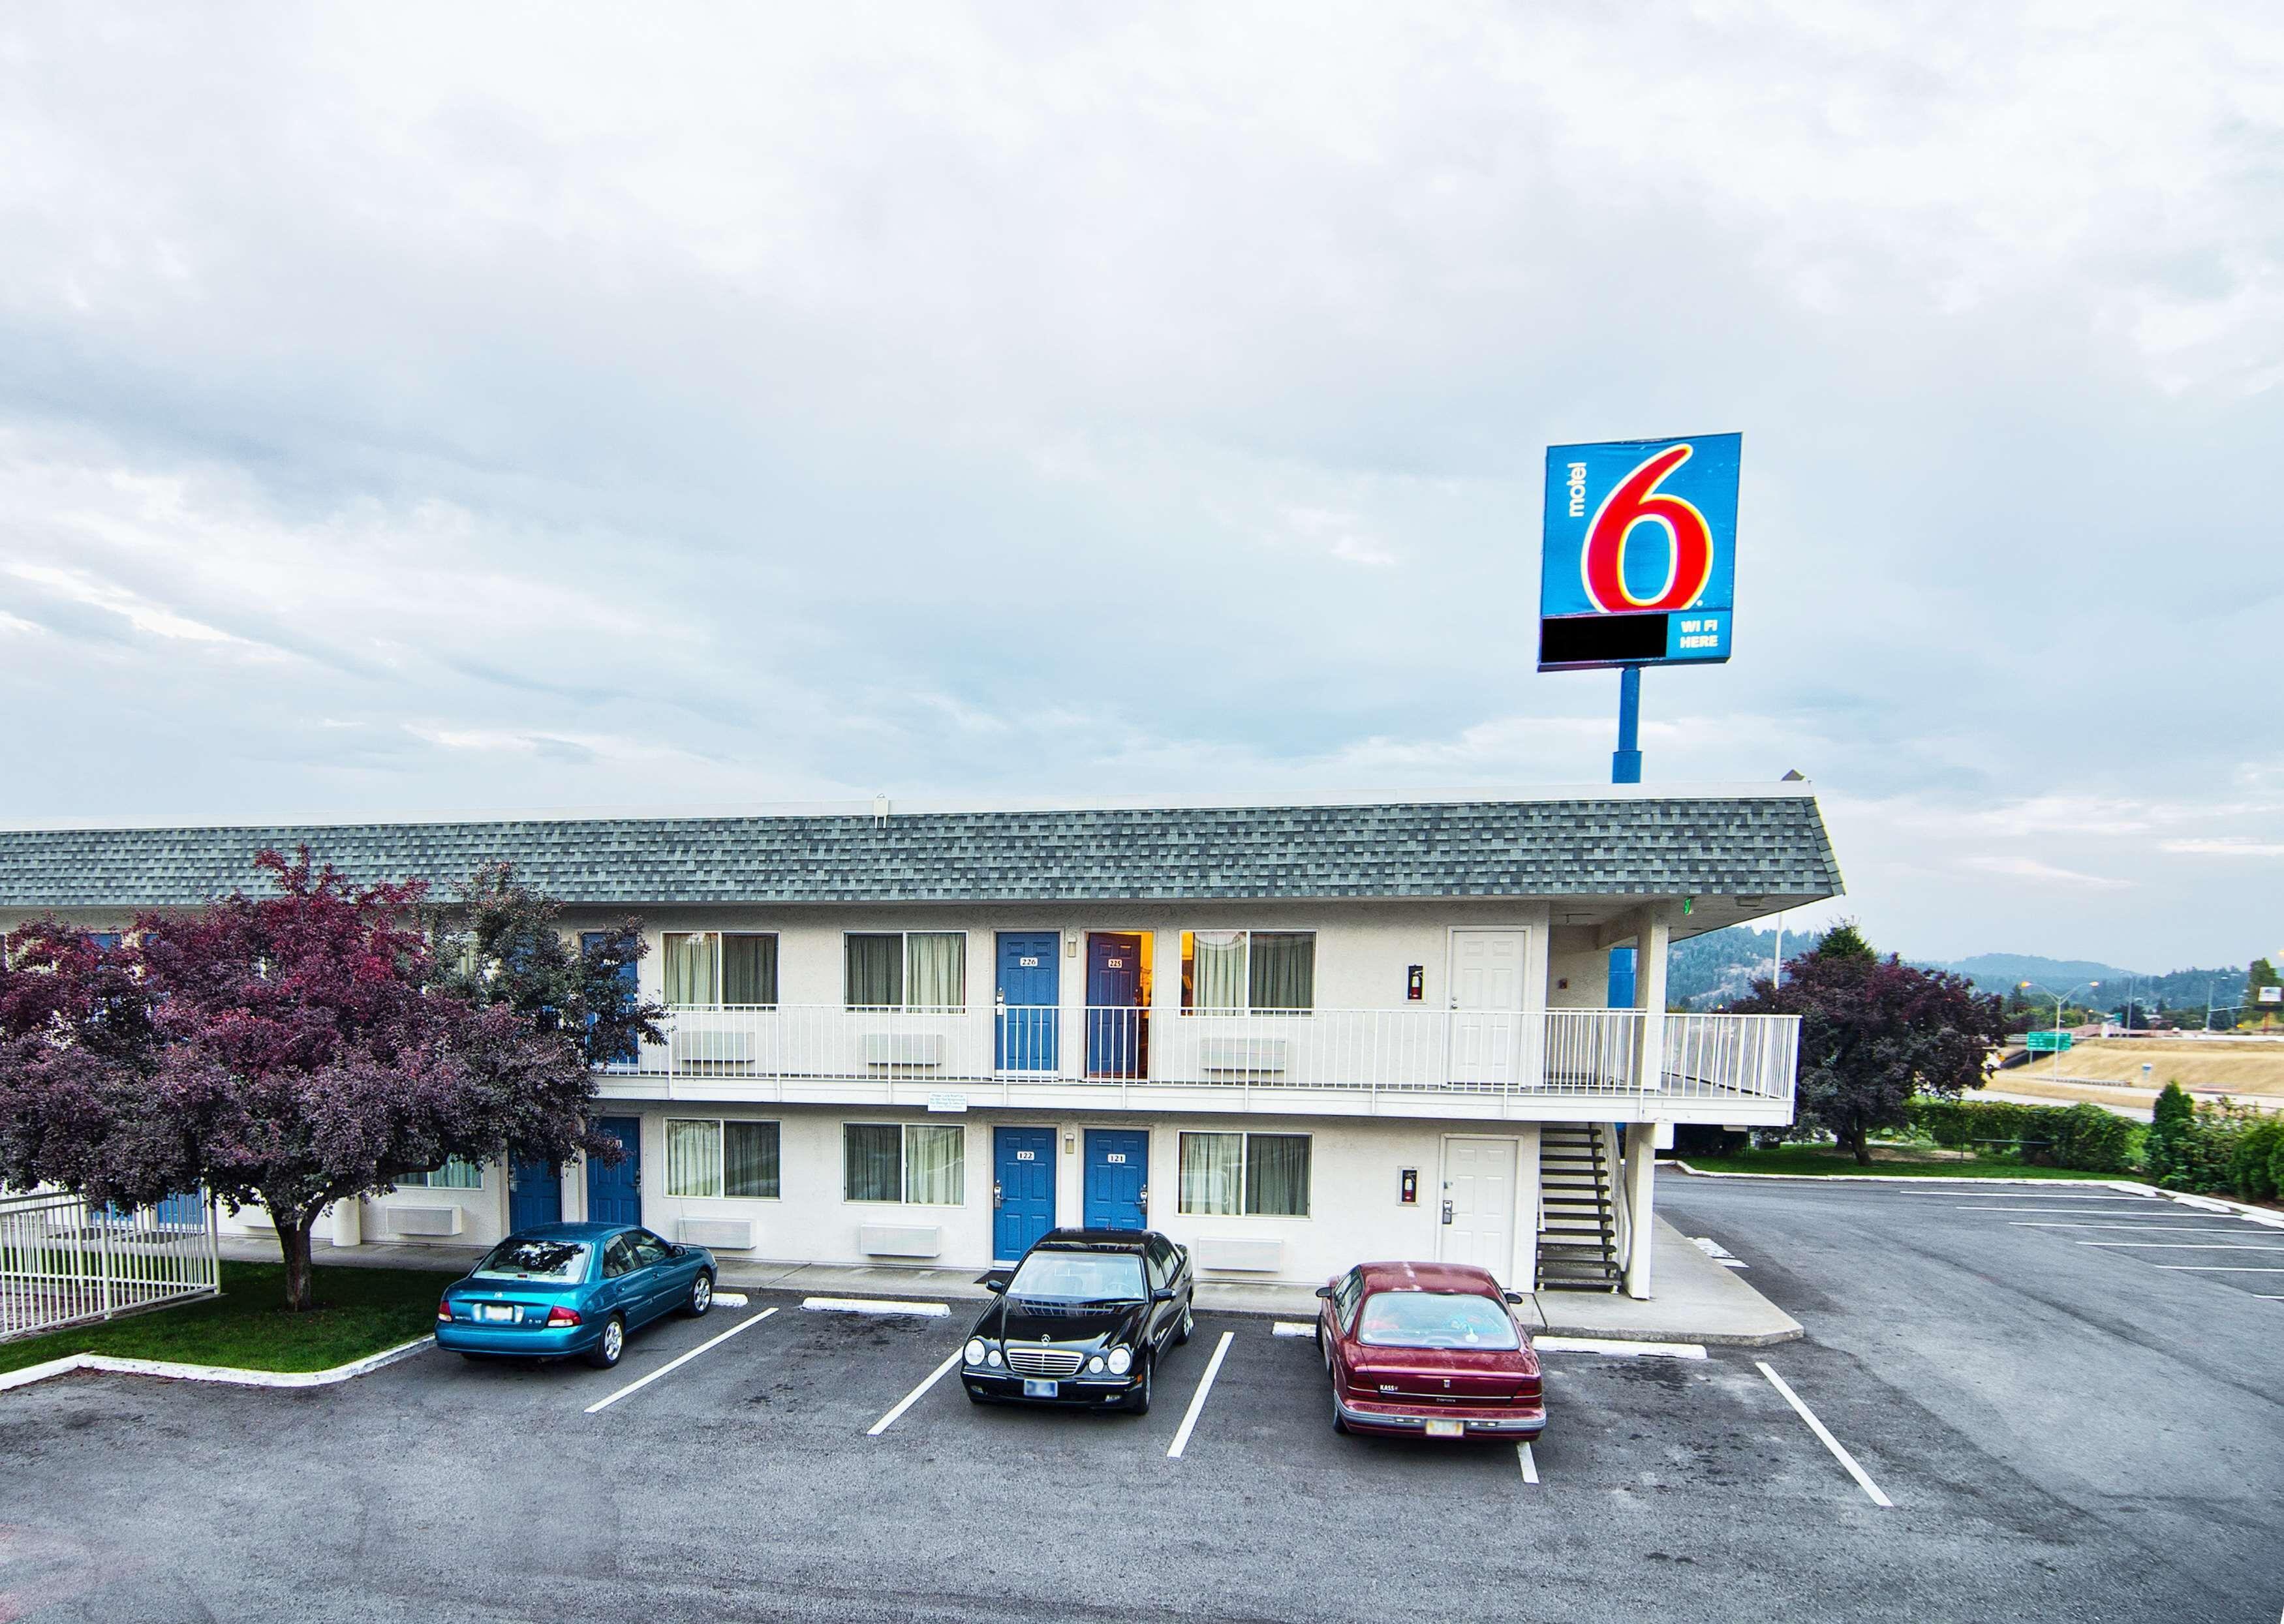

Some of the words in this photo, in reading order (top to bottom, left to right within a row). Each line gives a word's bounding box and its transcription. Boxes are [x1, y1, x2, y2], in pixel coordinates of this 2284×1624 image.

[1567, 462, 1586, 517] motel
[1581, 444, 1714, 613] 6
[1680, 634, 1718, 649] HERE
[1681, 620, 1701, 633] WI
[1704, 619, 1718, 632] FI
